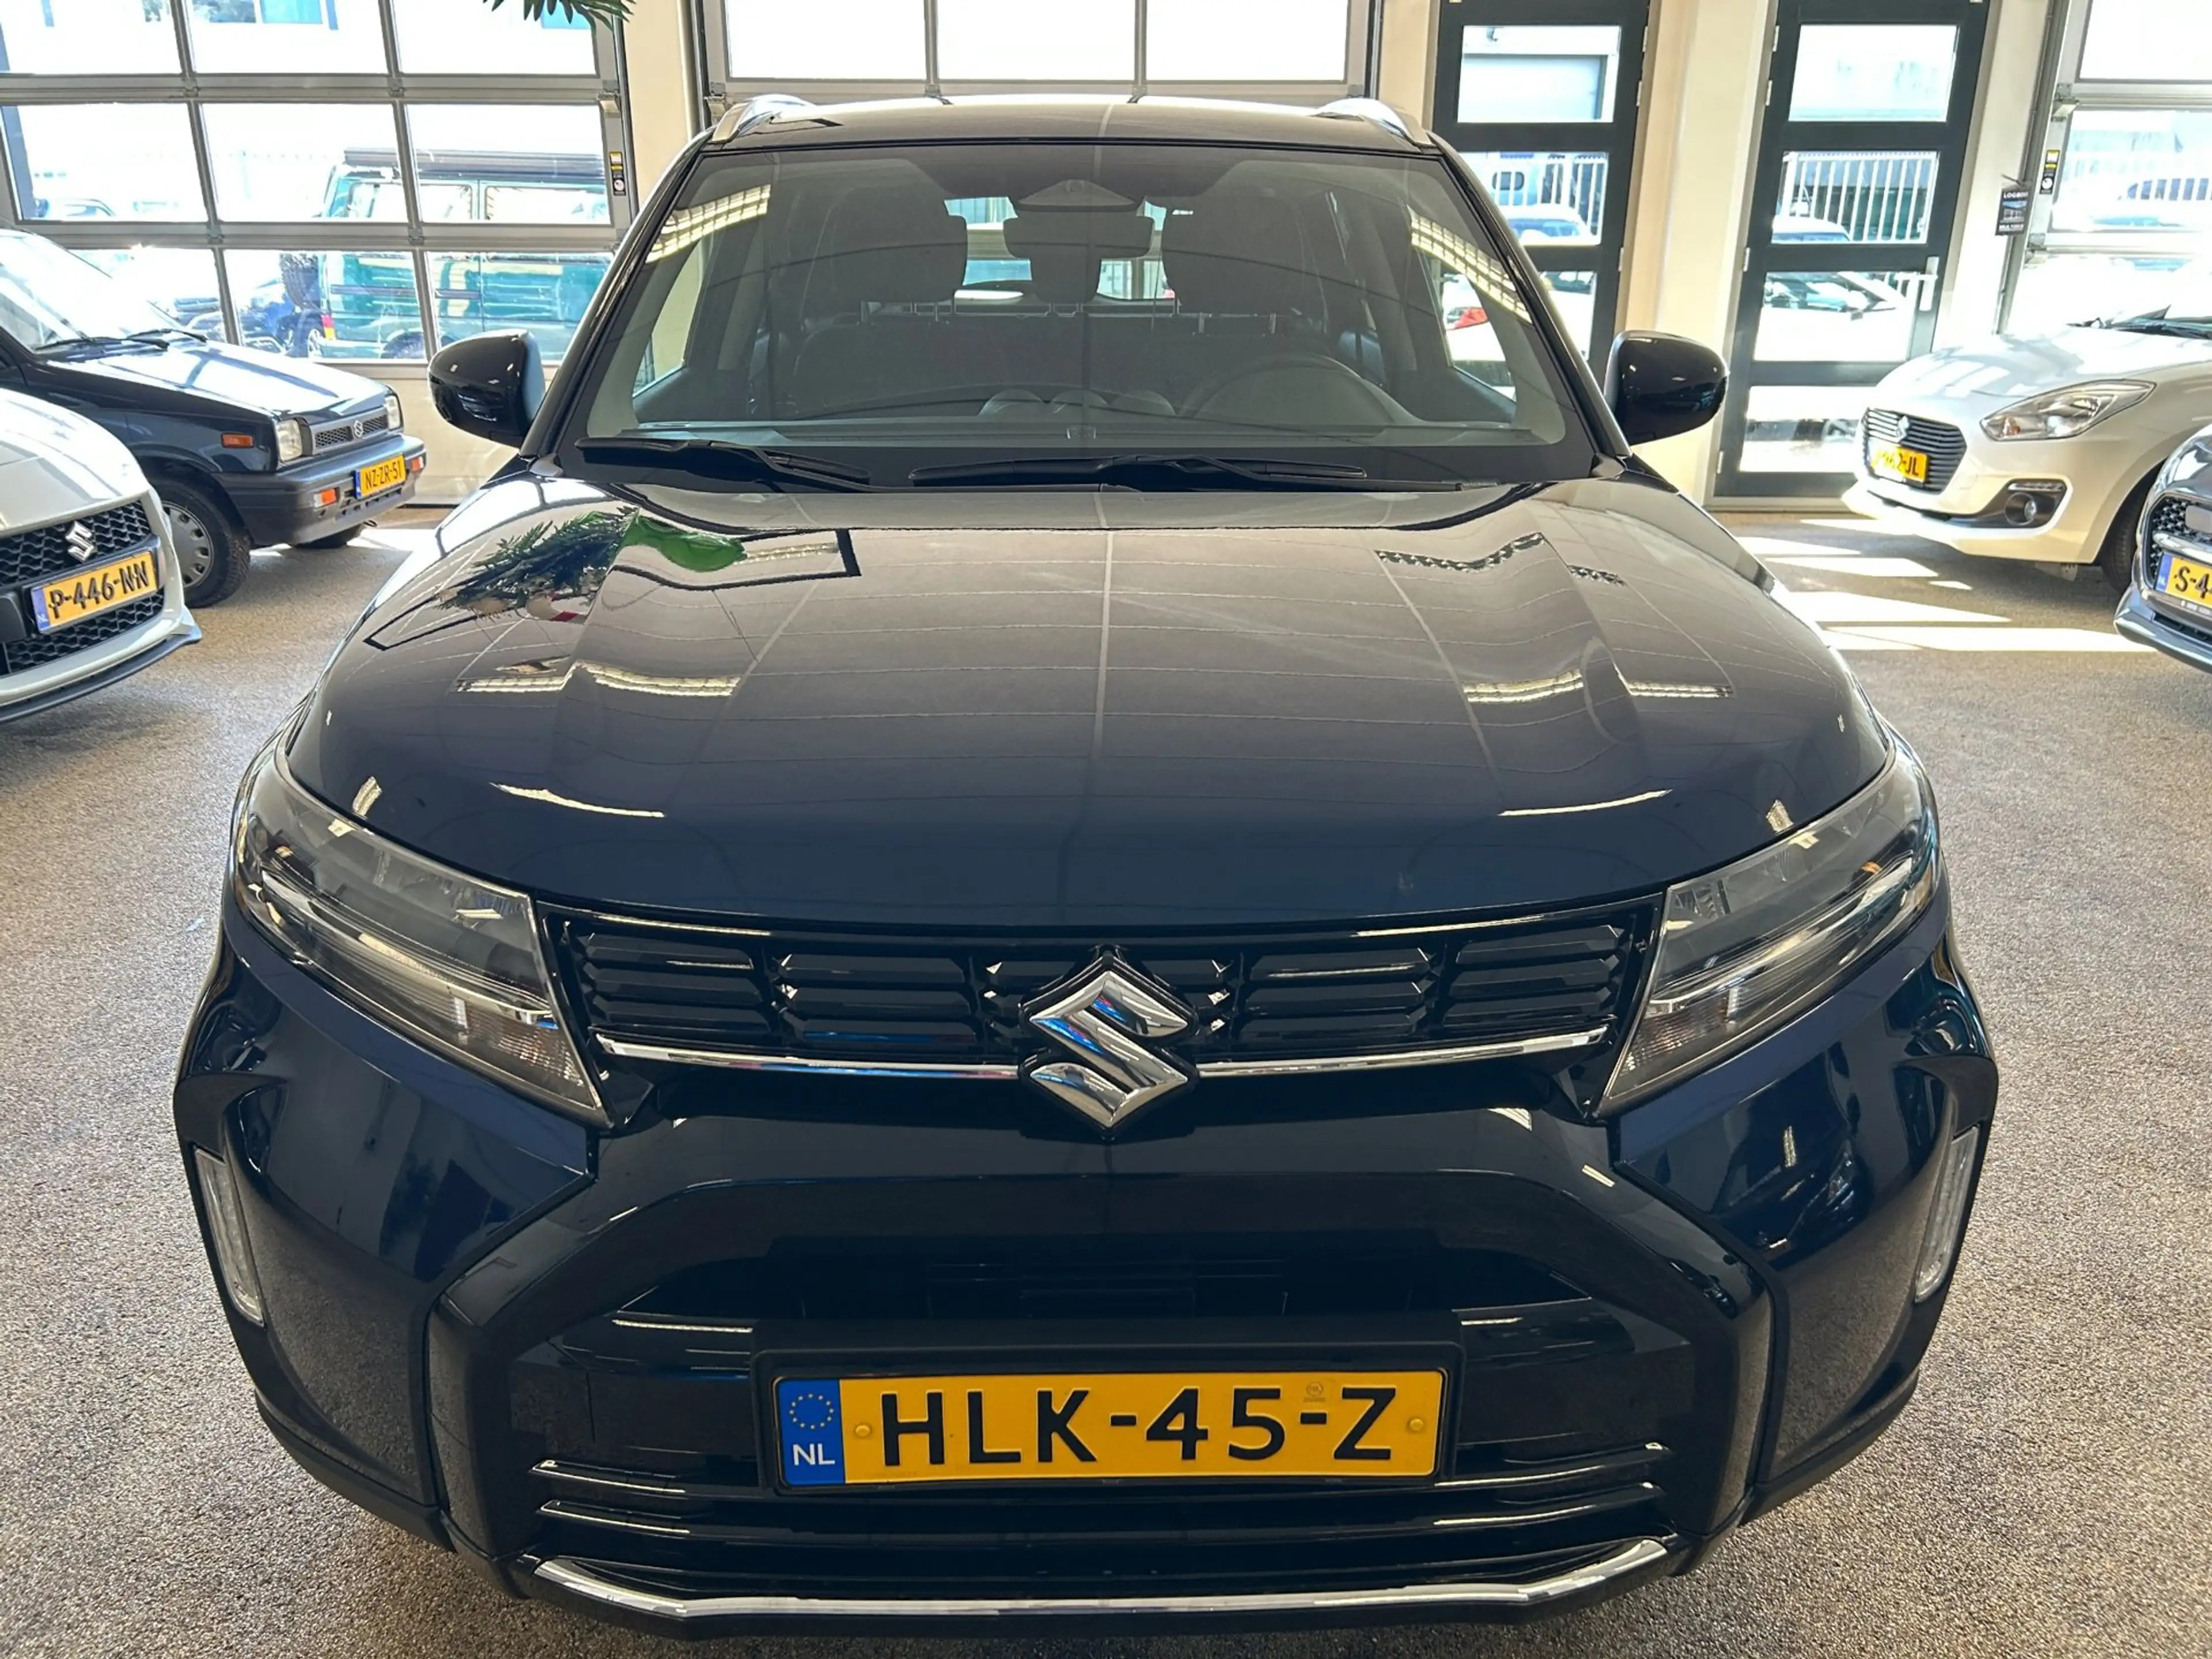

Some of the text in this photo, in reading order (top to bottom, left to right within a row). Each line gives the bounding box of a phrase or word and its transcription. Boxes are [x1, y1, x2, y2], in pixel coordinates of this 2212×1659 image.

[365, 460, 402, 490] NZ-ZR-51
[50, 560, 149, 619] P-446-NN
[792, 1443, 835, 1466] NL
[881, 1386, 1397, 1466] HLK-45-Z
